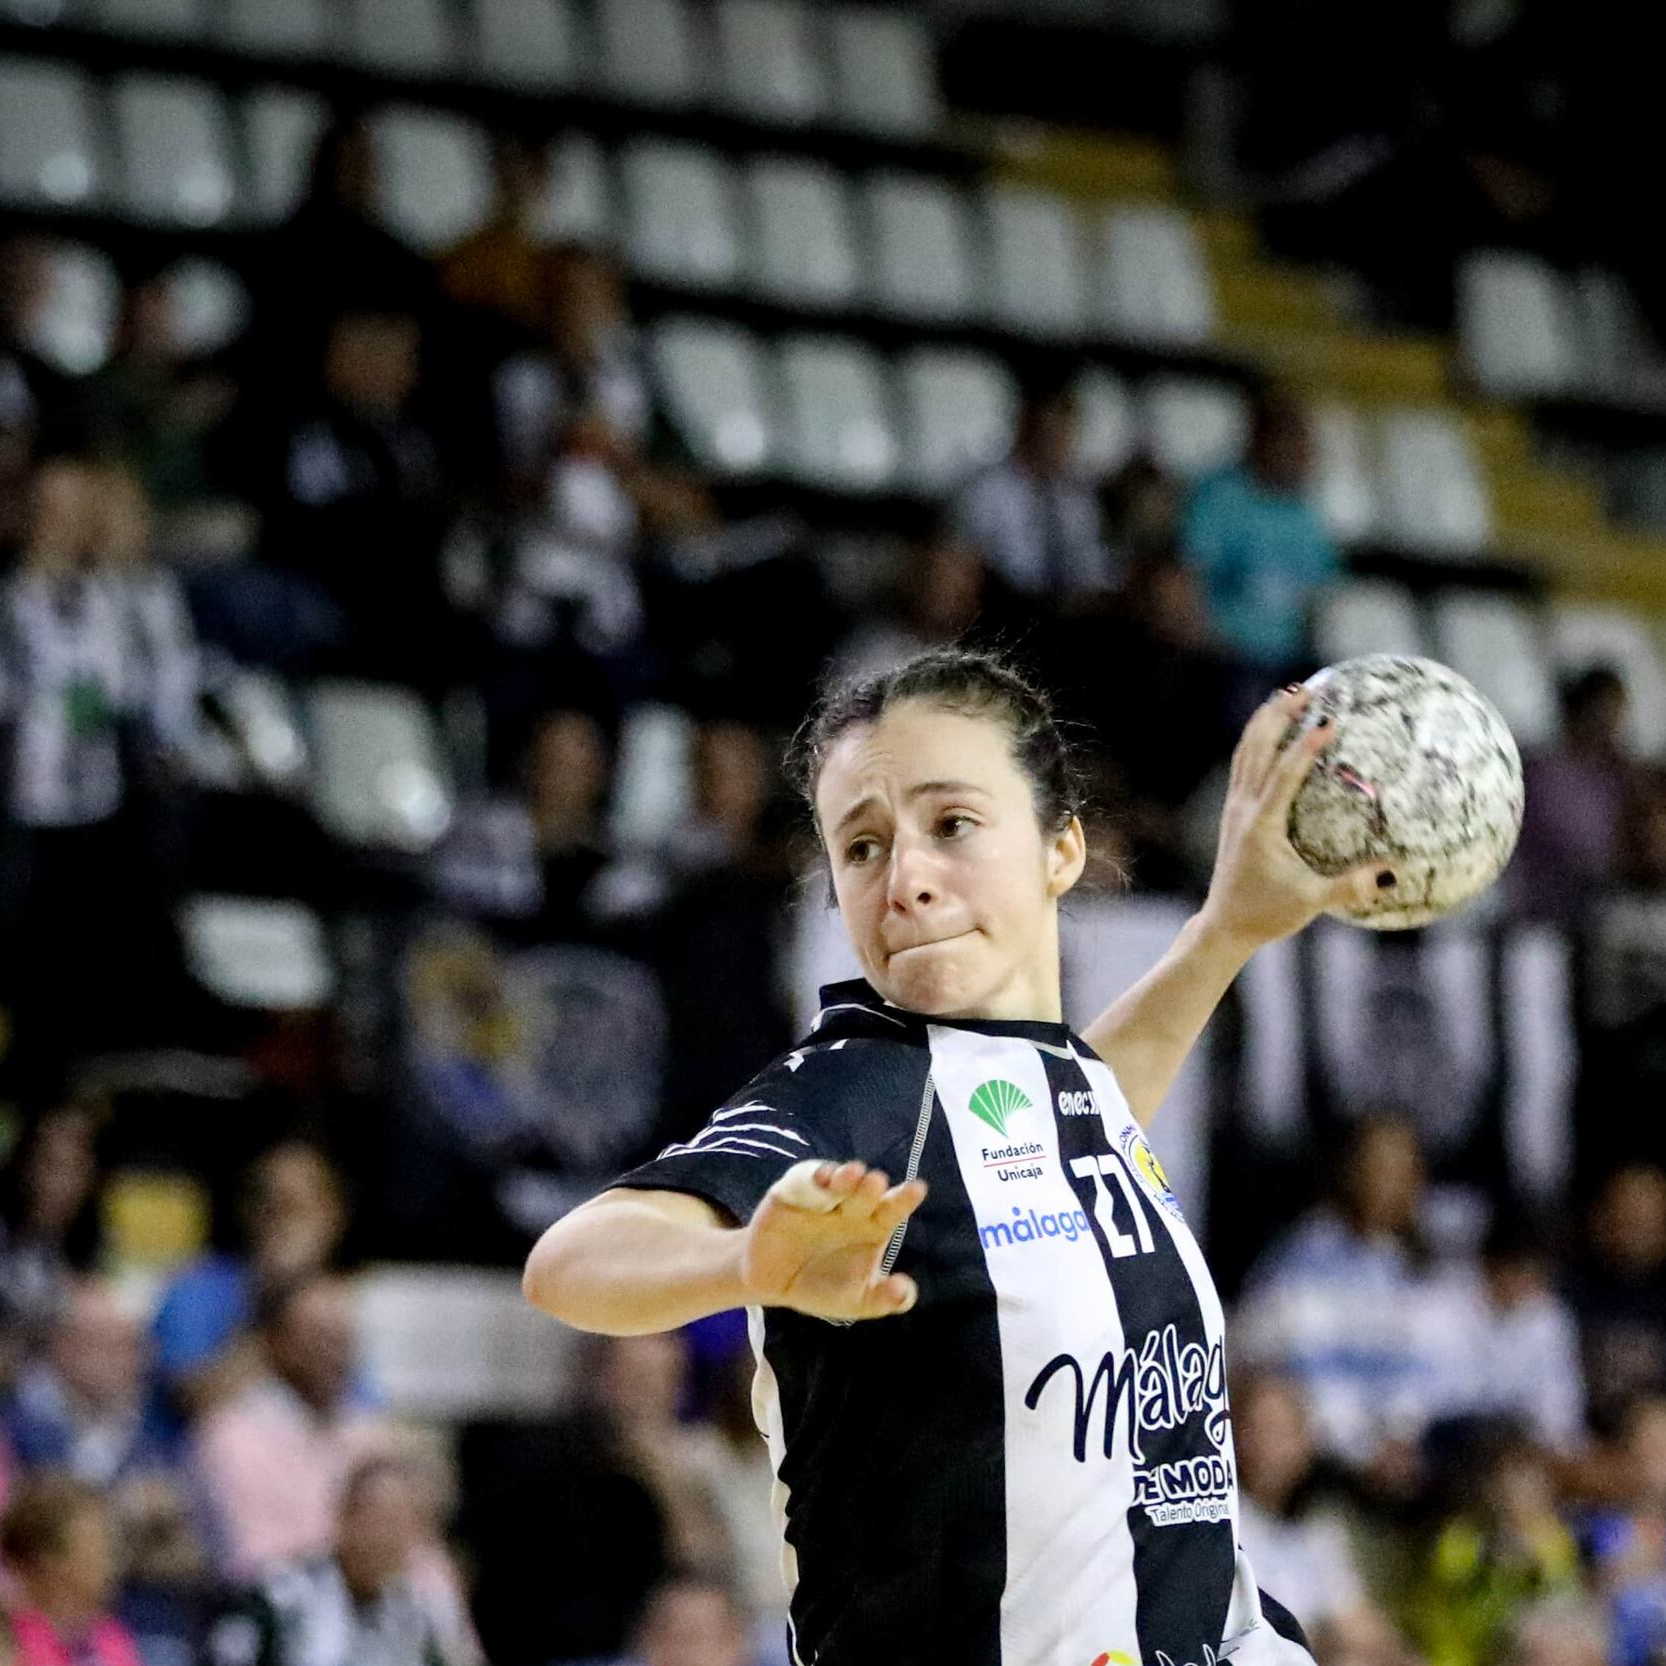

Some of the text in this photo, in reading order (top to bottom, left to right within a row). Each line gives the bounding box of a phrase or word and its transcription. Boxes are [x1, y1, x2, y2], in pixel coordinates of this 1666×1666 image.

[981, 1142, 1045, 1161] Fundación
[997, 1164, 1044, 1182] Unicaja
[1069, 1153, 1156, 1259] 27
[979, 1206, 1092, 1249] málaga
[1024, 1324, 1231, 1463] Málag
[1151, 1501, 1230, 1523] Talento Origina
